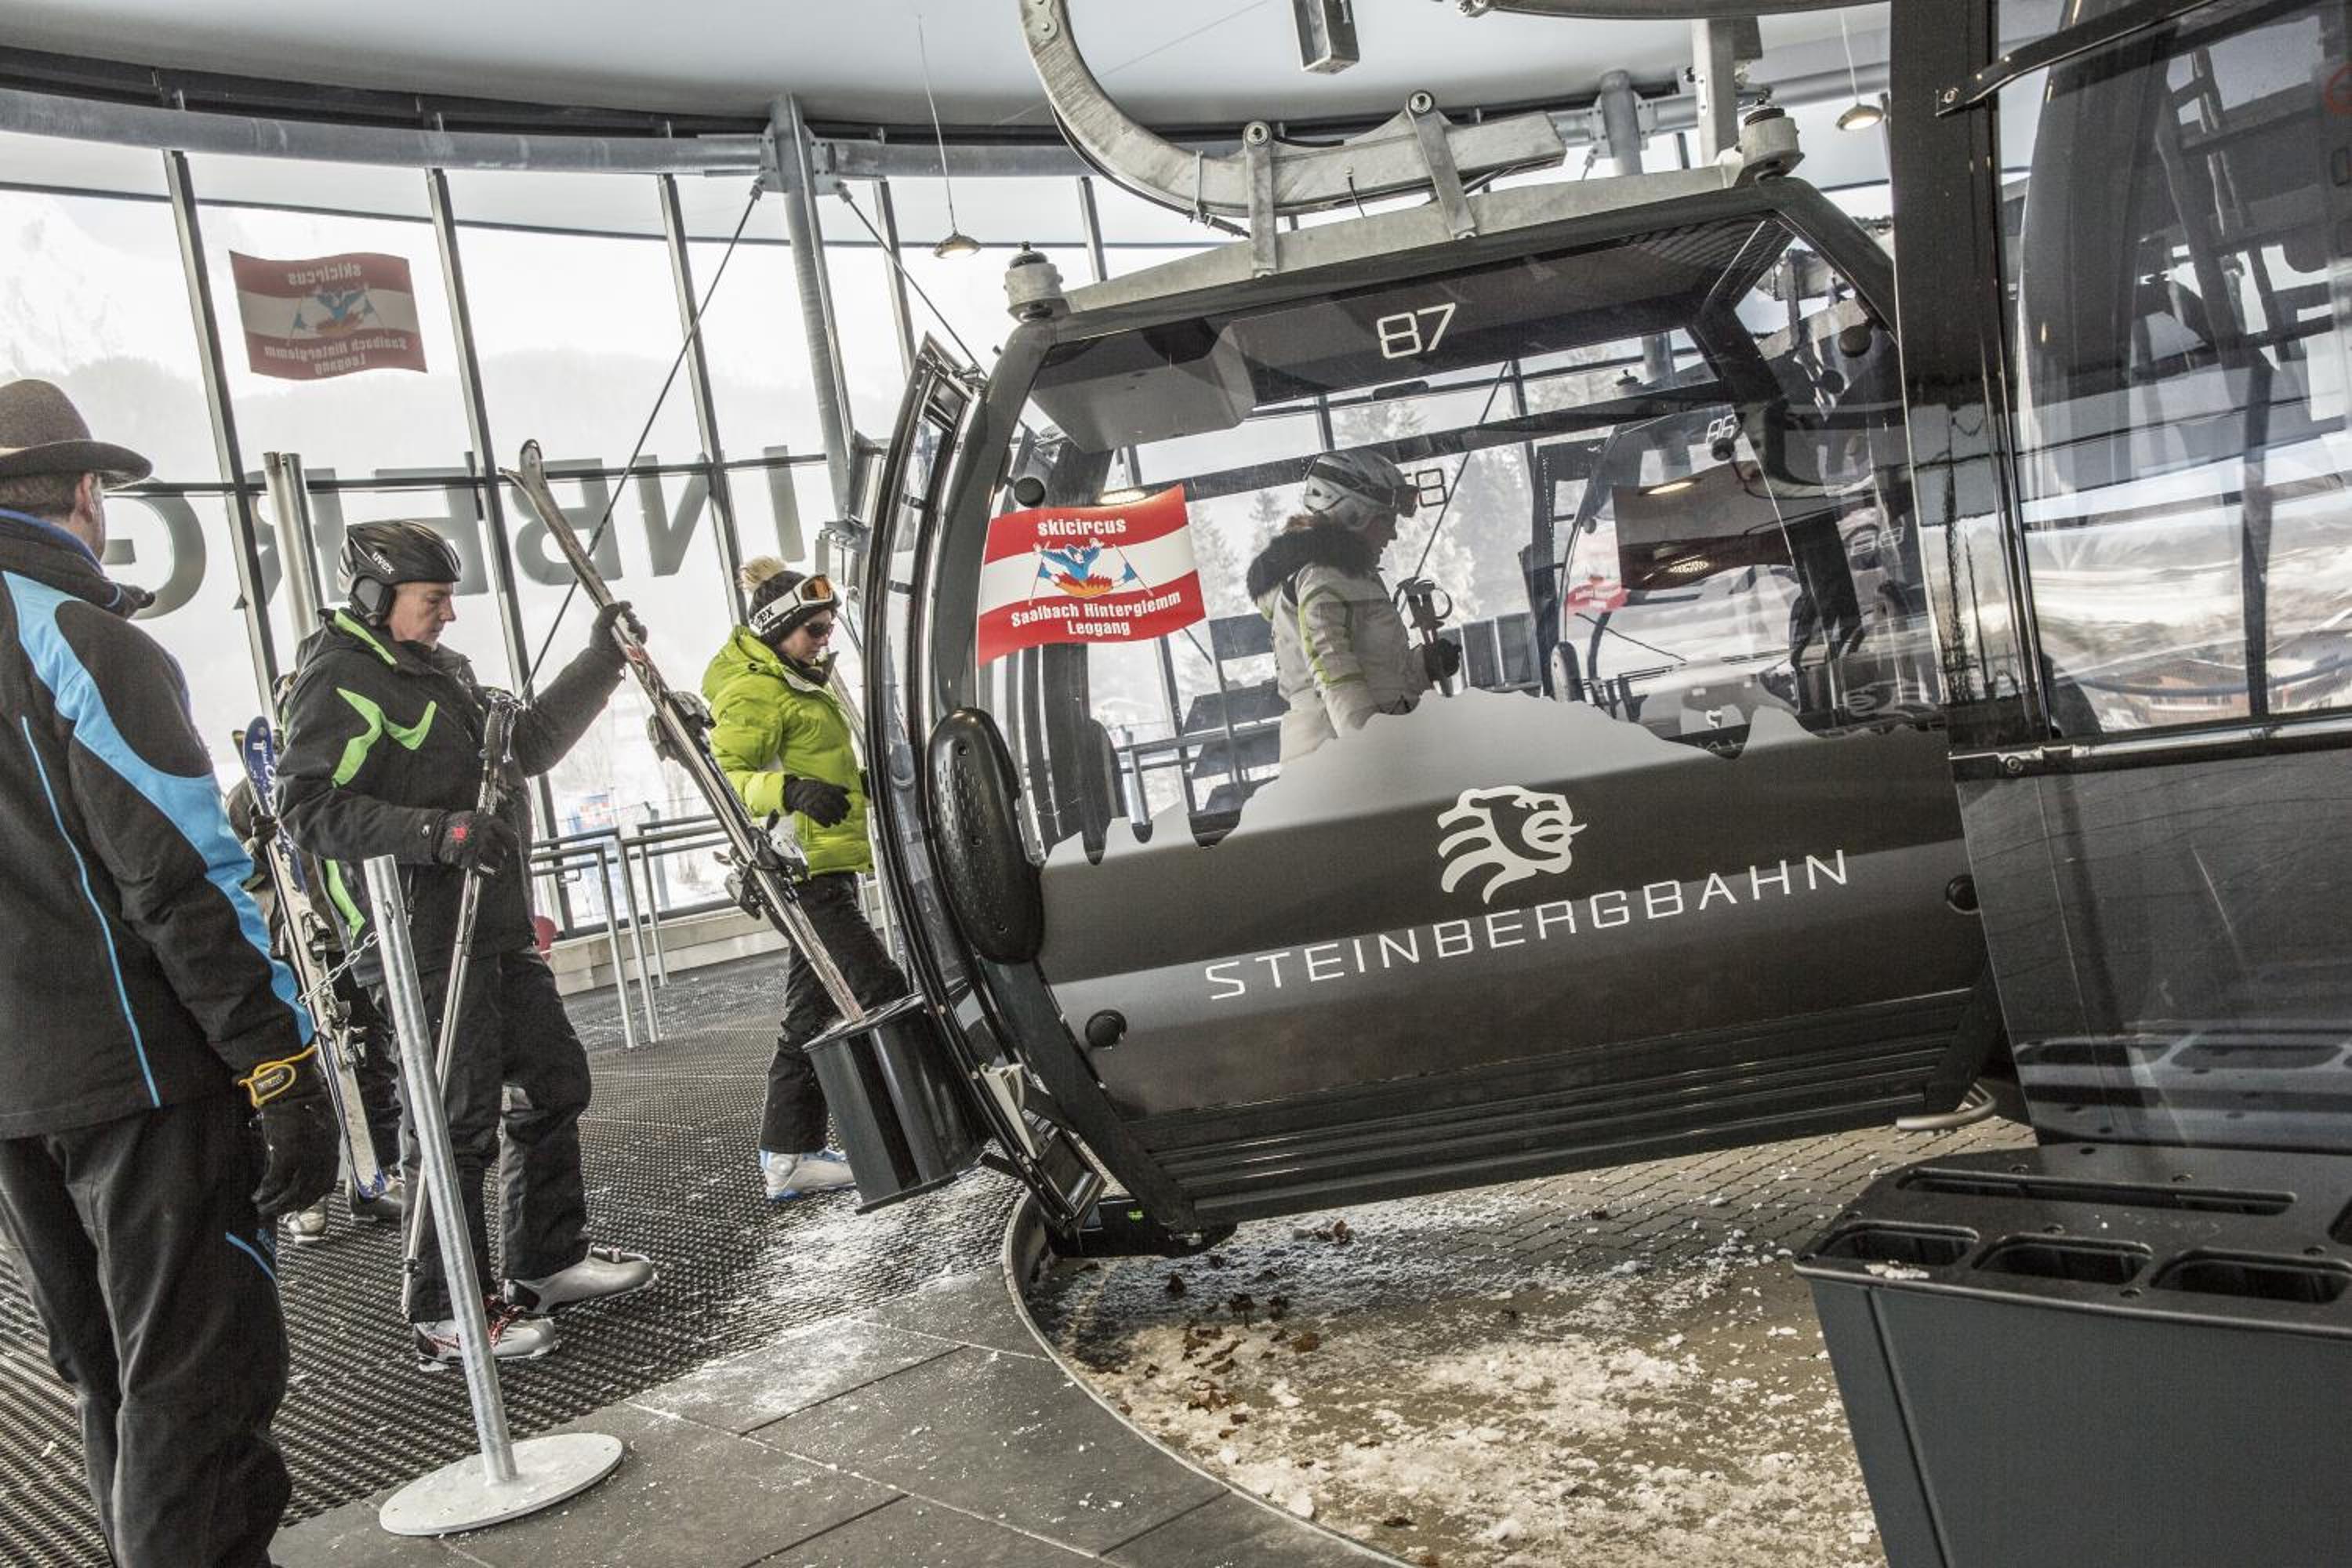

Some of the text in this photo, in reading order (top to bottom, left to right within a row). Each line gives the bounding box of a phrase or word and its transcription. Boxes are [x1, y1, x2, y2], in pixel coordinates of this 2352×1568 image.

[1377, 302, 1456, 359] 87
[1037, 517, 1127, 536] skicircus
[372, 551, 395, 575] uvex
[1011, 591, 1181, 627] Saalbach Hinterglemm
[1067, 620, 1131, 637] Leogang
[1204, 849, 1848, 1000] STEINBERGBAHN
